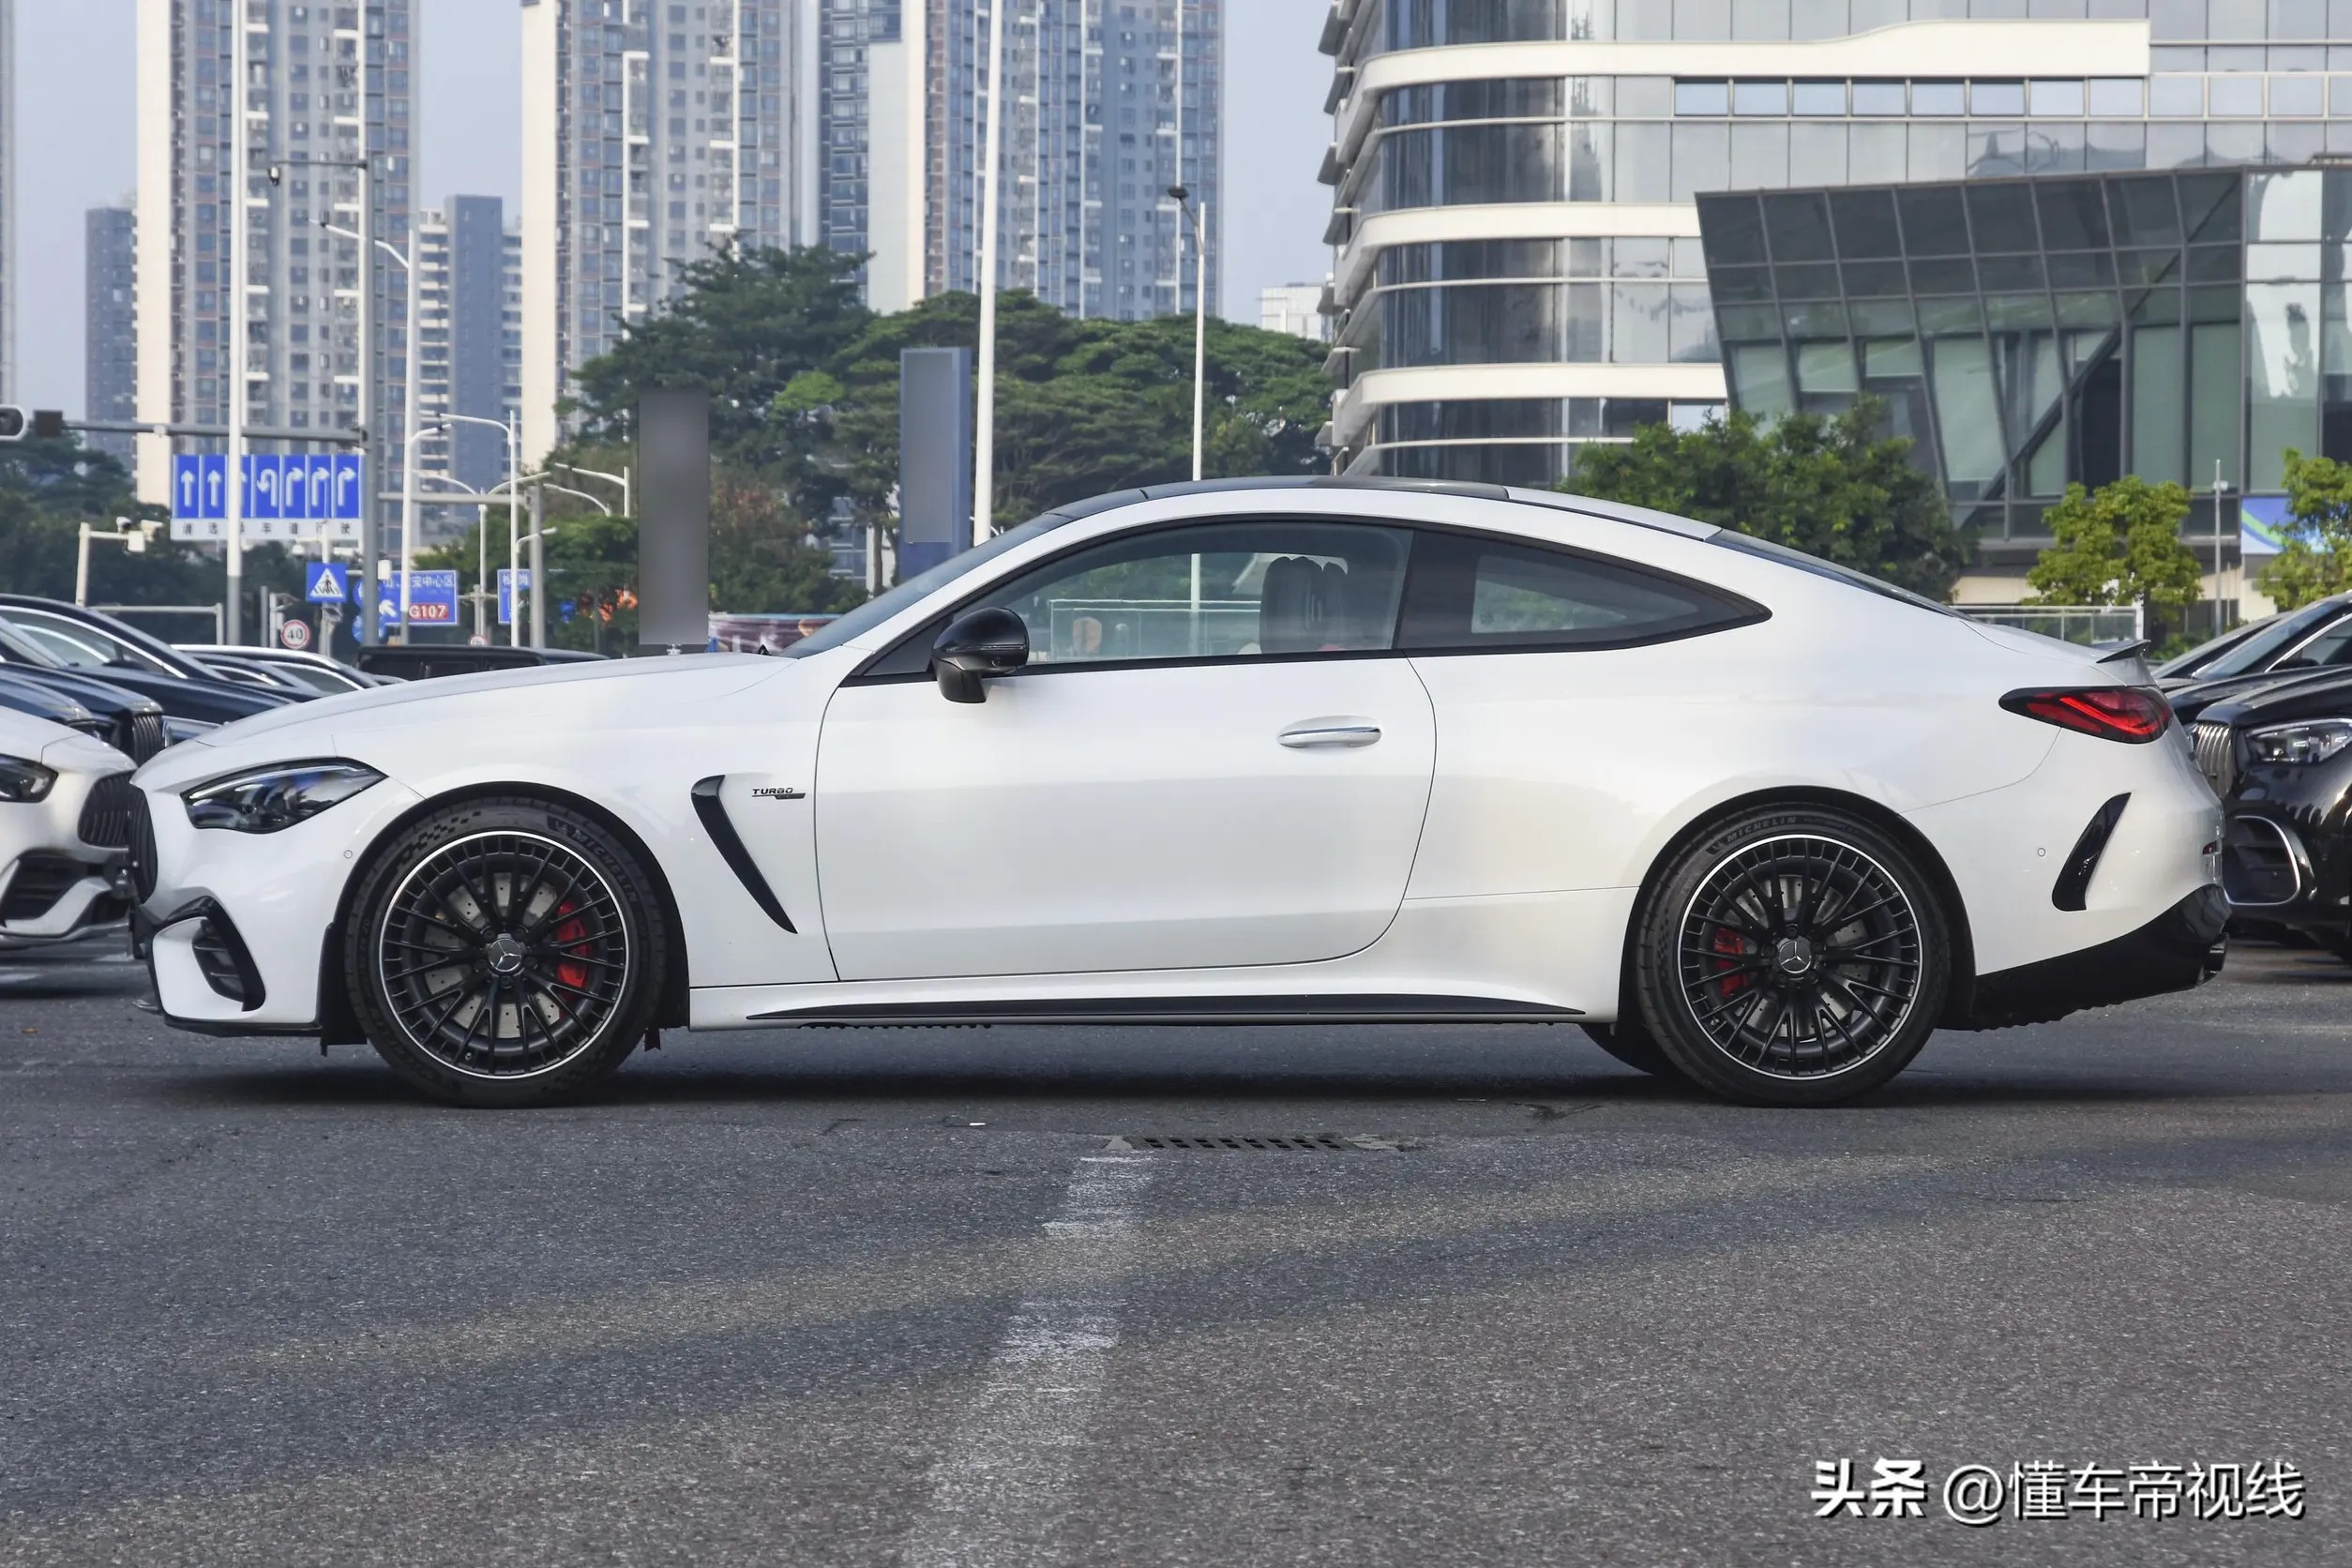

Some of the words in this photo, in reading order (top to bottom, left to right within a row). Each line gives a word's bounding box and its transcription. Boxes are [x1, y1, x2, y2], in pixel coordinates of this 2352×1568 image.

[409, 605, 446, 618] G107
[287, 628, 303, 639] 40
[752, 787, 793, 795] TURBO
[1726, 816, 1797, 843] MICHELIN
[571, 829, 639, 902] MICHELIN
